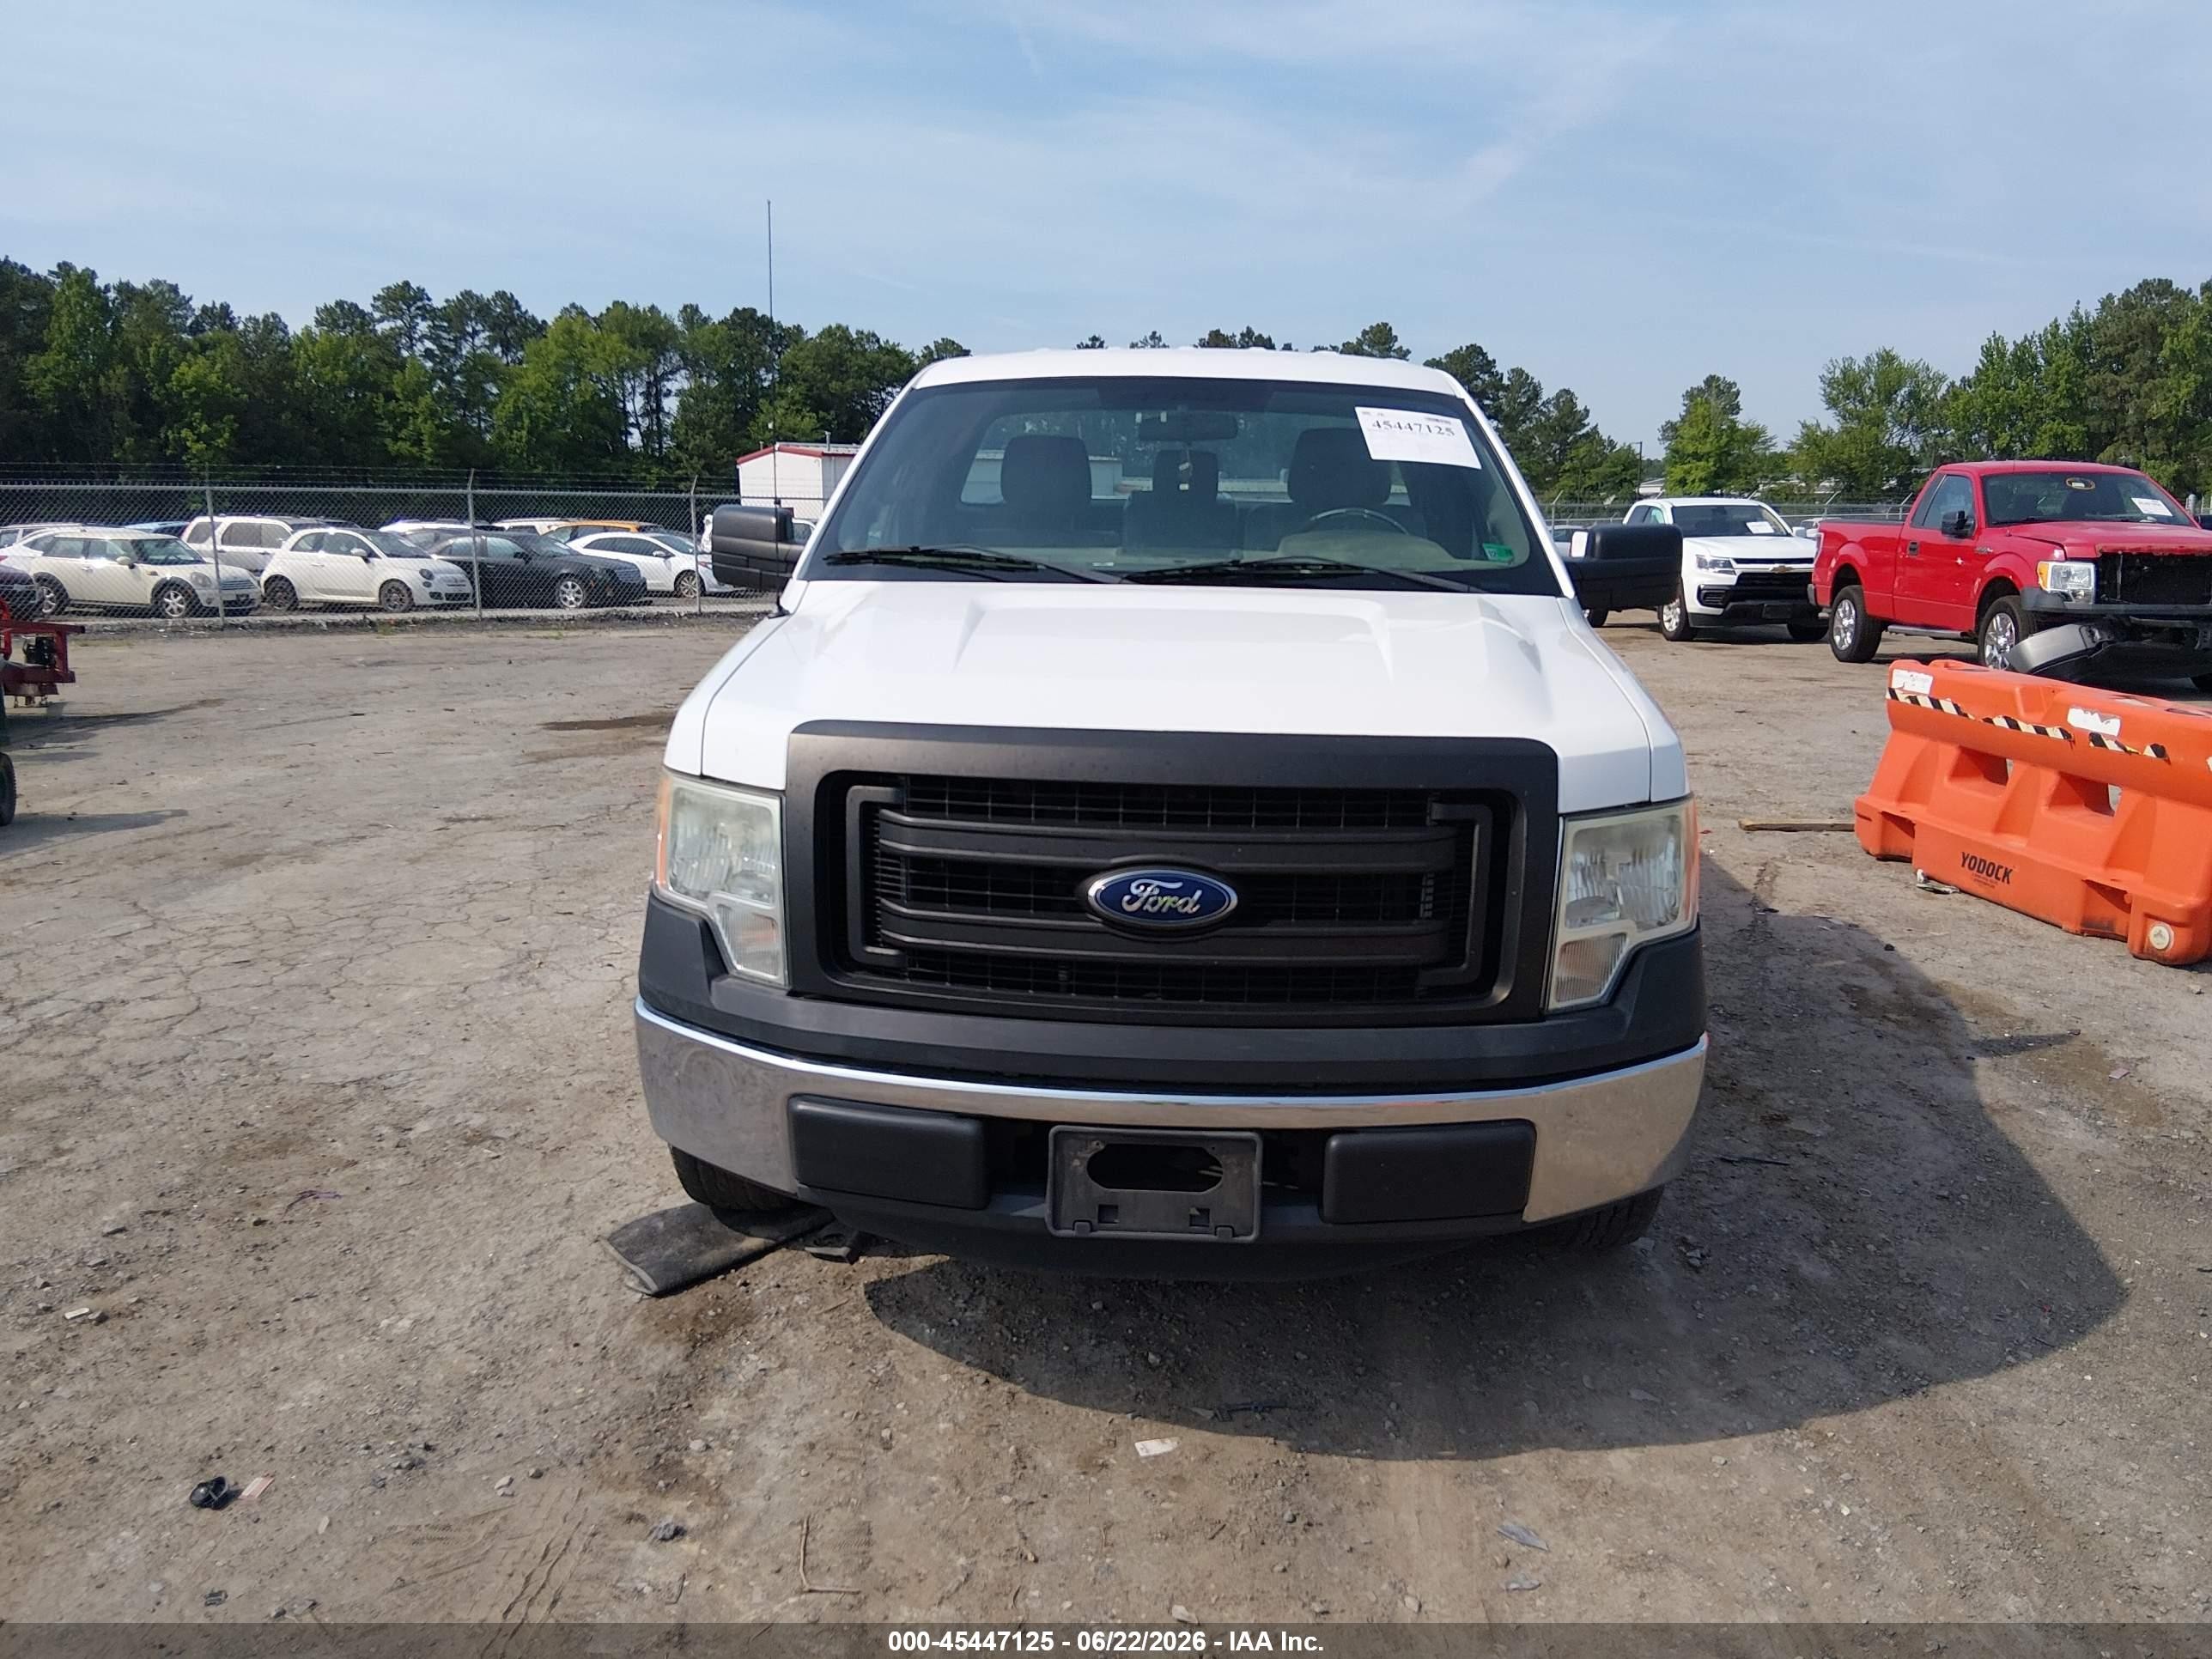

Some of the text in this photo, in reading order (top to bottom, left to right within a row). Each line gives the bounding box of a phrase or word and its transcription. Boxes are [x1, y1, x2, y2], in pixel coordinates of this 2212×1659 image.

[1372, 420, 1455, 436] 45447125
[1961, 852, 2013, 884] YODOCK
[1121, 878, 1203, 915] Ford
